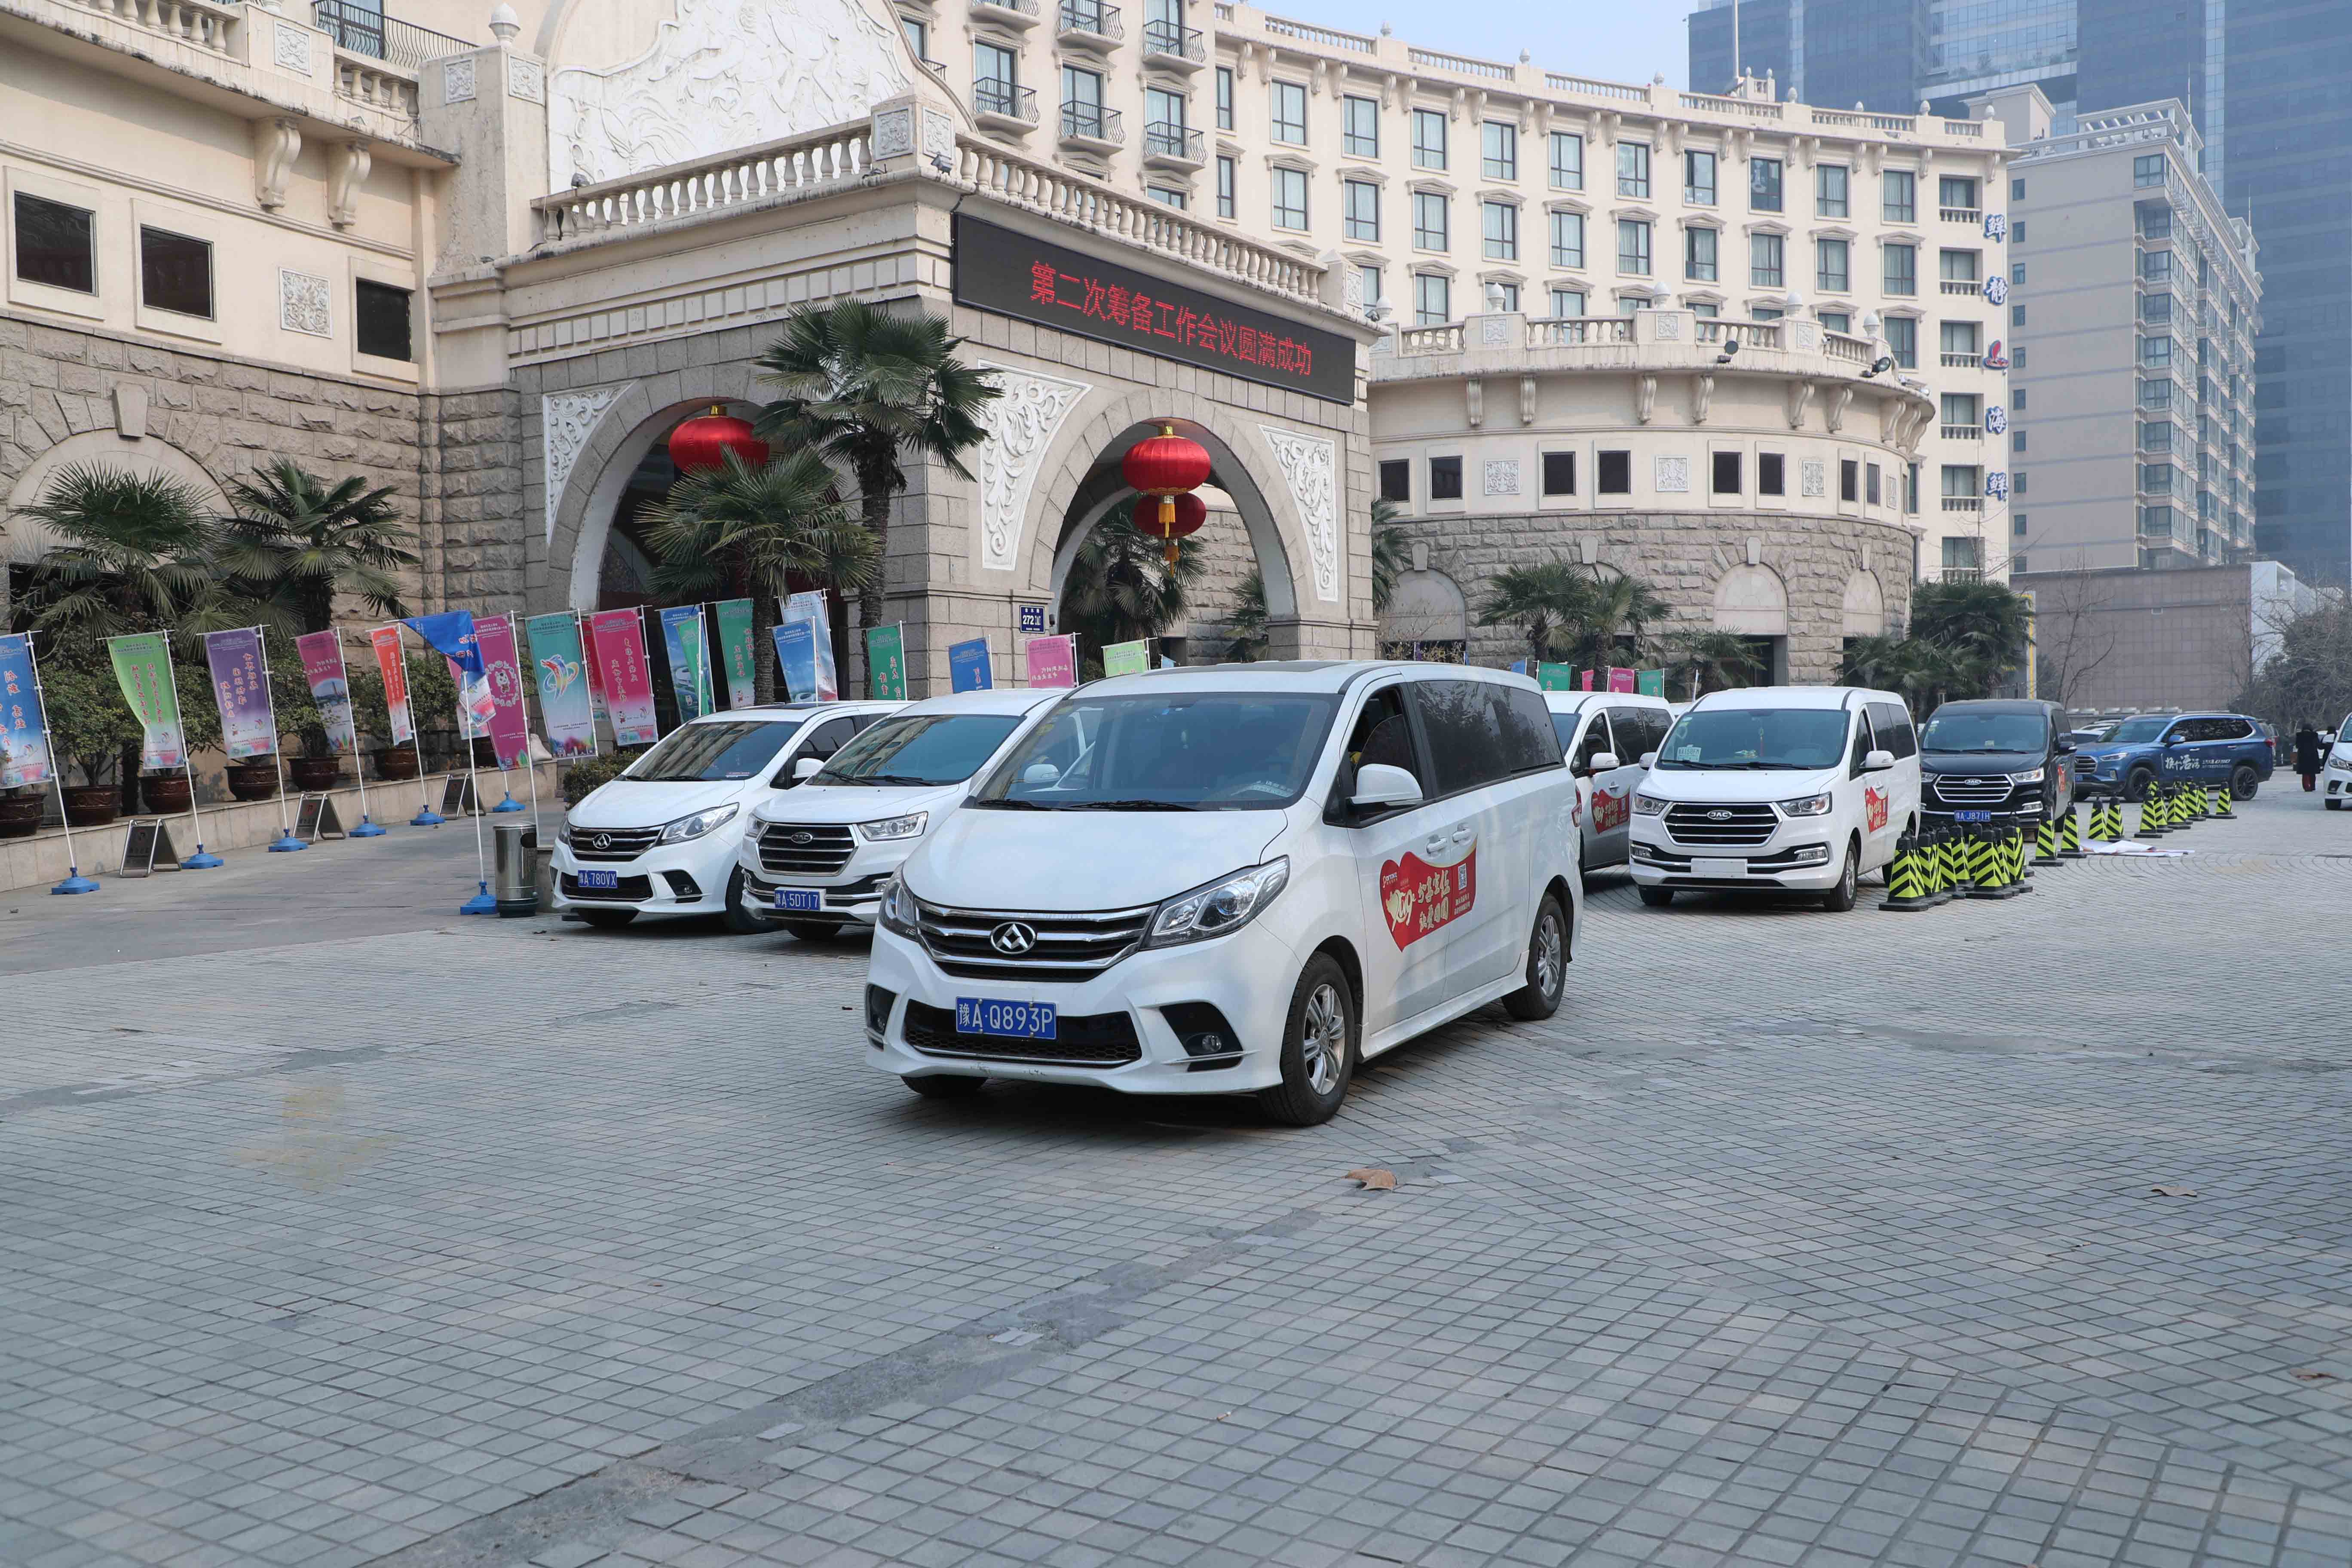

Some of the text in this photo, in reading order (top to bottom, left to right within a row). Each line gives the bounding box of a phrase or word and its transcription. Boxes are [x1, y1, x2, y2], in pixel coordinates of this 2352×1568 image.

[1031, 260, 1311, 375] 第二次筹备工作会议圆满成功
[1023, 615, 1034, 625] 272
